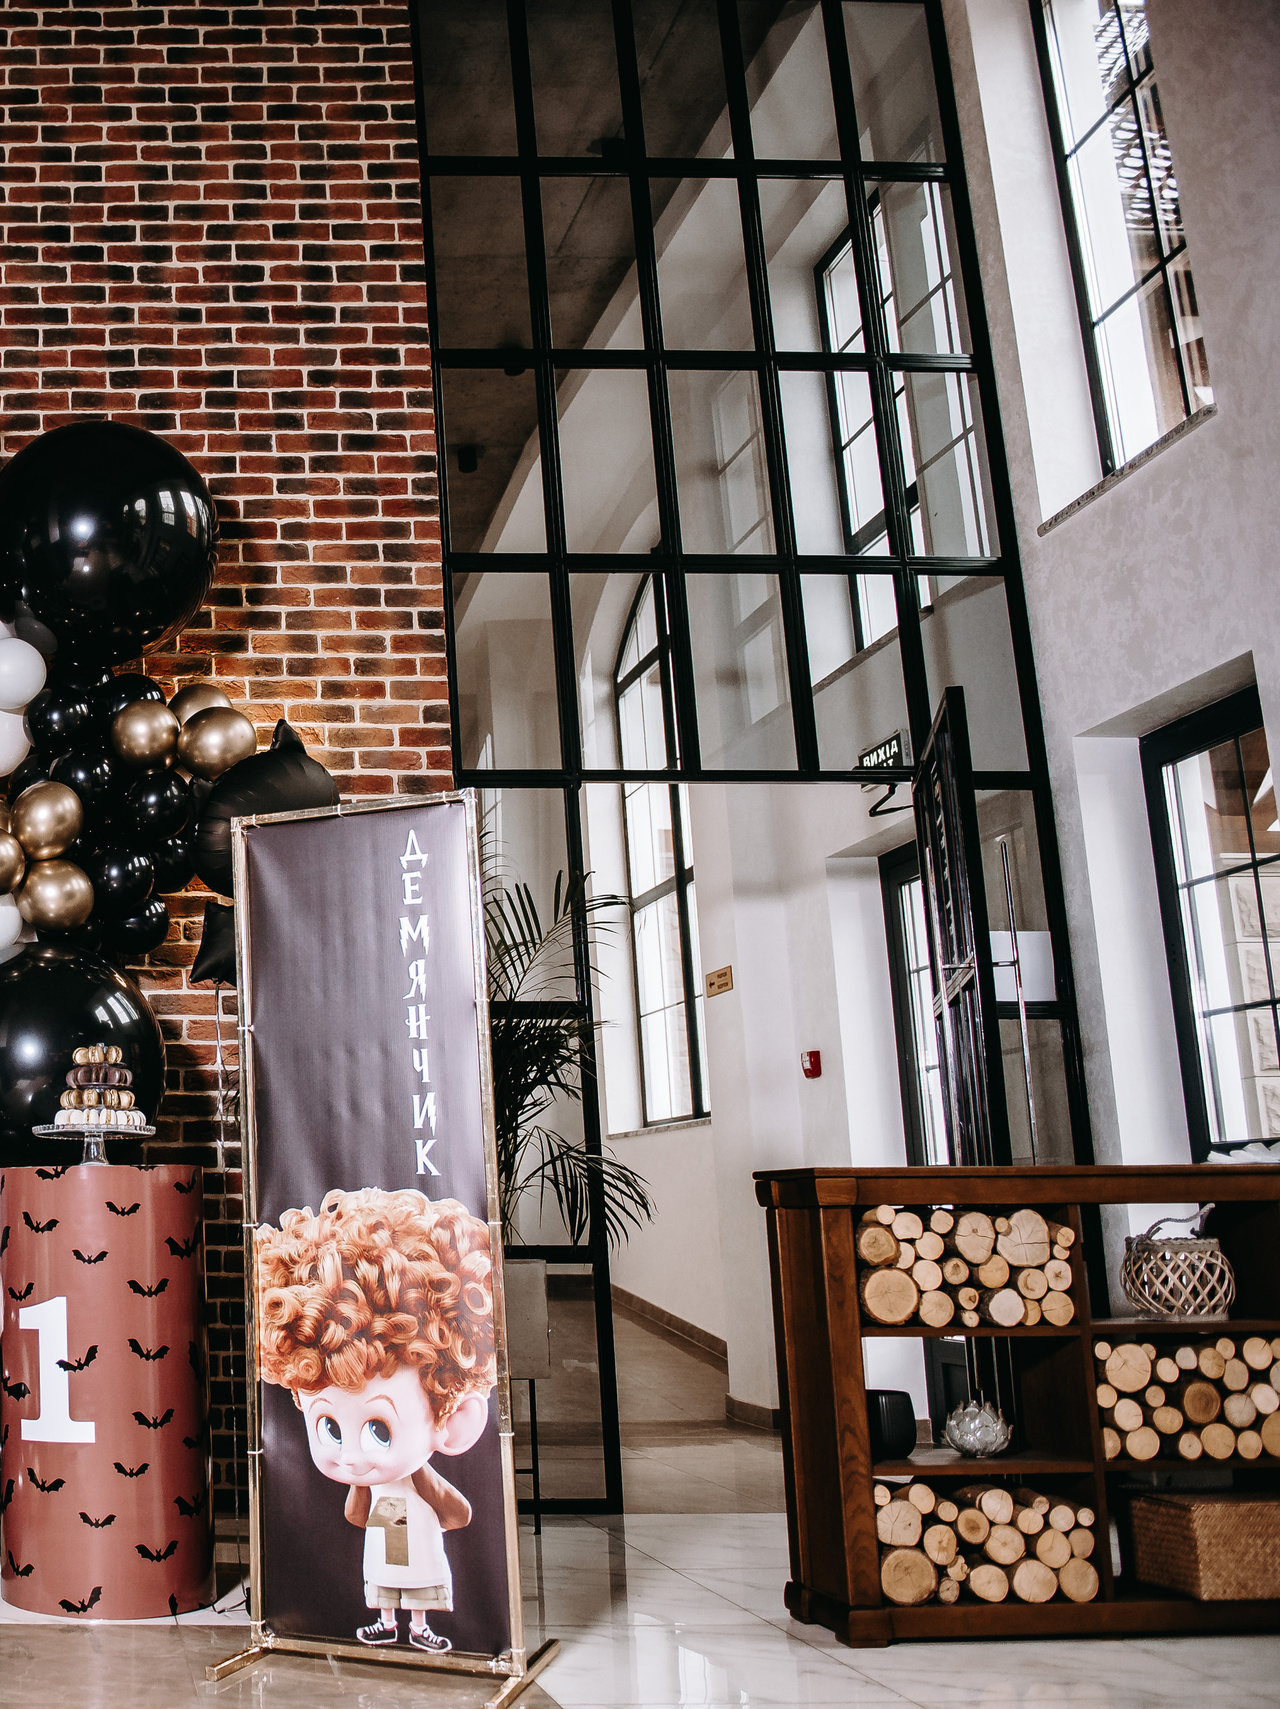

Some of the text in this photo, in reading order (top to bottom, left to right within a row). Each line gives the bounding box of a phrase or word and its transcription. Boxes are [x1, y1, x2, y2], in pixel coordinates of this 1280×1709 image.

[863, 740, 898, 766] ВИХІД
[399, 829, 441, 1177] ДЕМЯНЧИК
[19, 1296, 96, 1443] 1
[365, 1496, 410, 1566] 1
